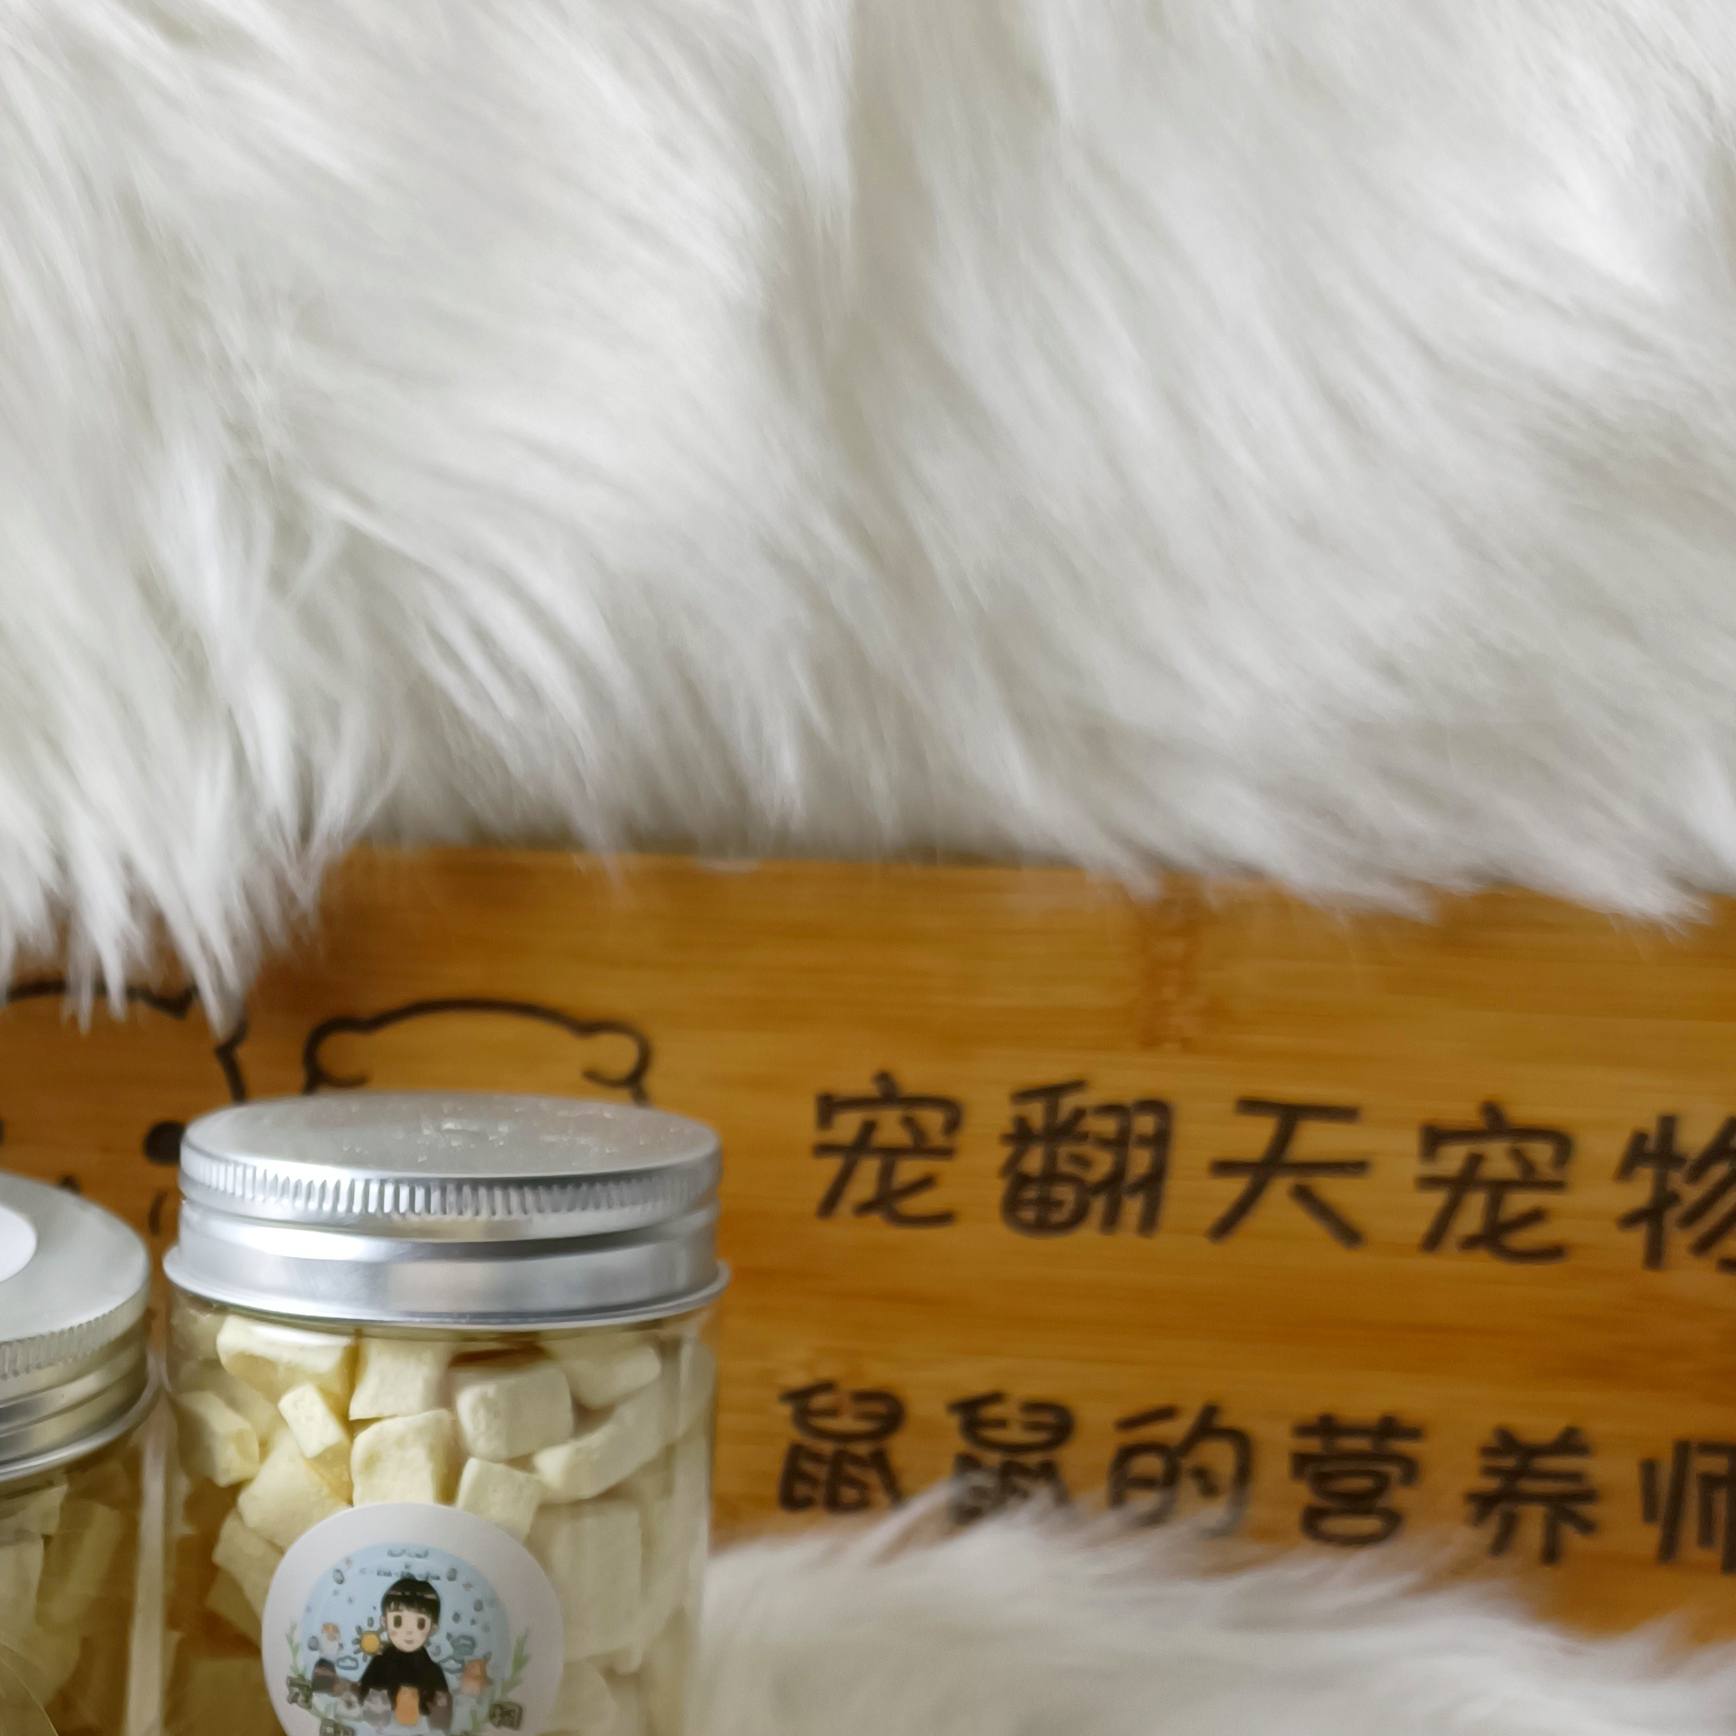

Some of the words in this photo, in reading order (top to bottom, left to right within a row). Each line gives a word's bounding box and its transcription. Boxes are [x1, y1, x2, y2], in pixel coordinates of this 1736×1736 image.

[810, 1069, 1736, 1274] 宠翻天宠物
[776, 1378, 1736, 1576] 鼠鼠的营养师
